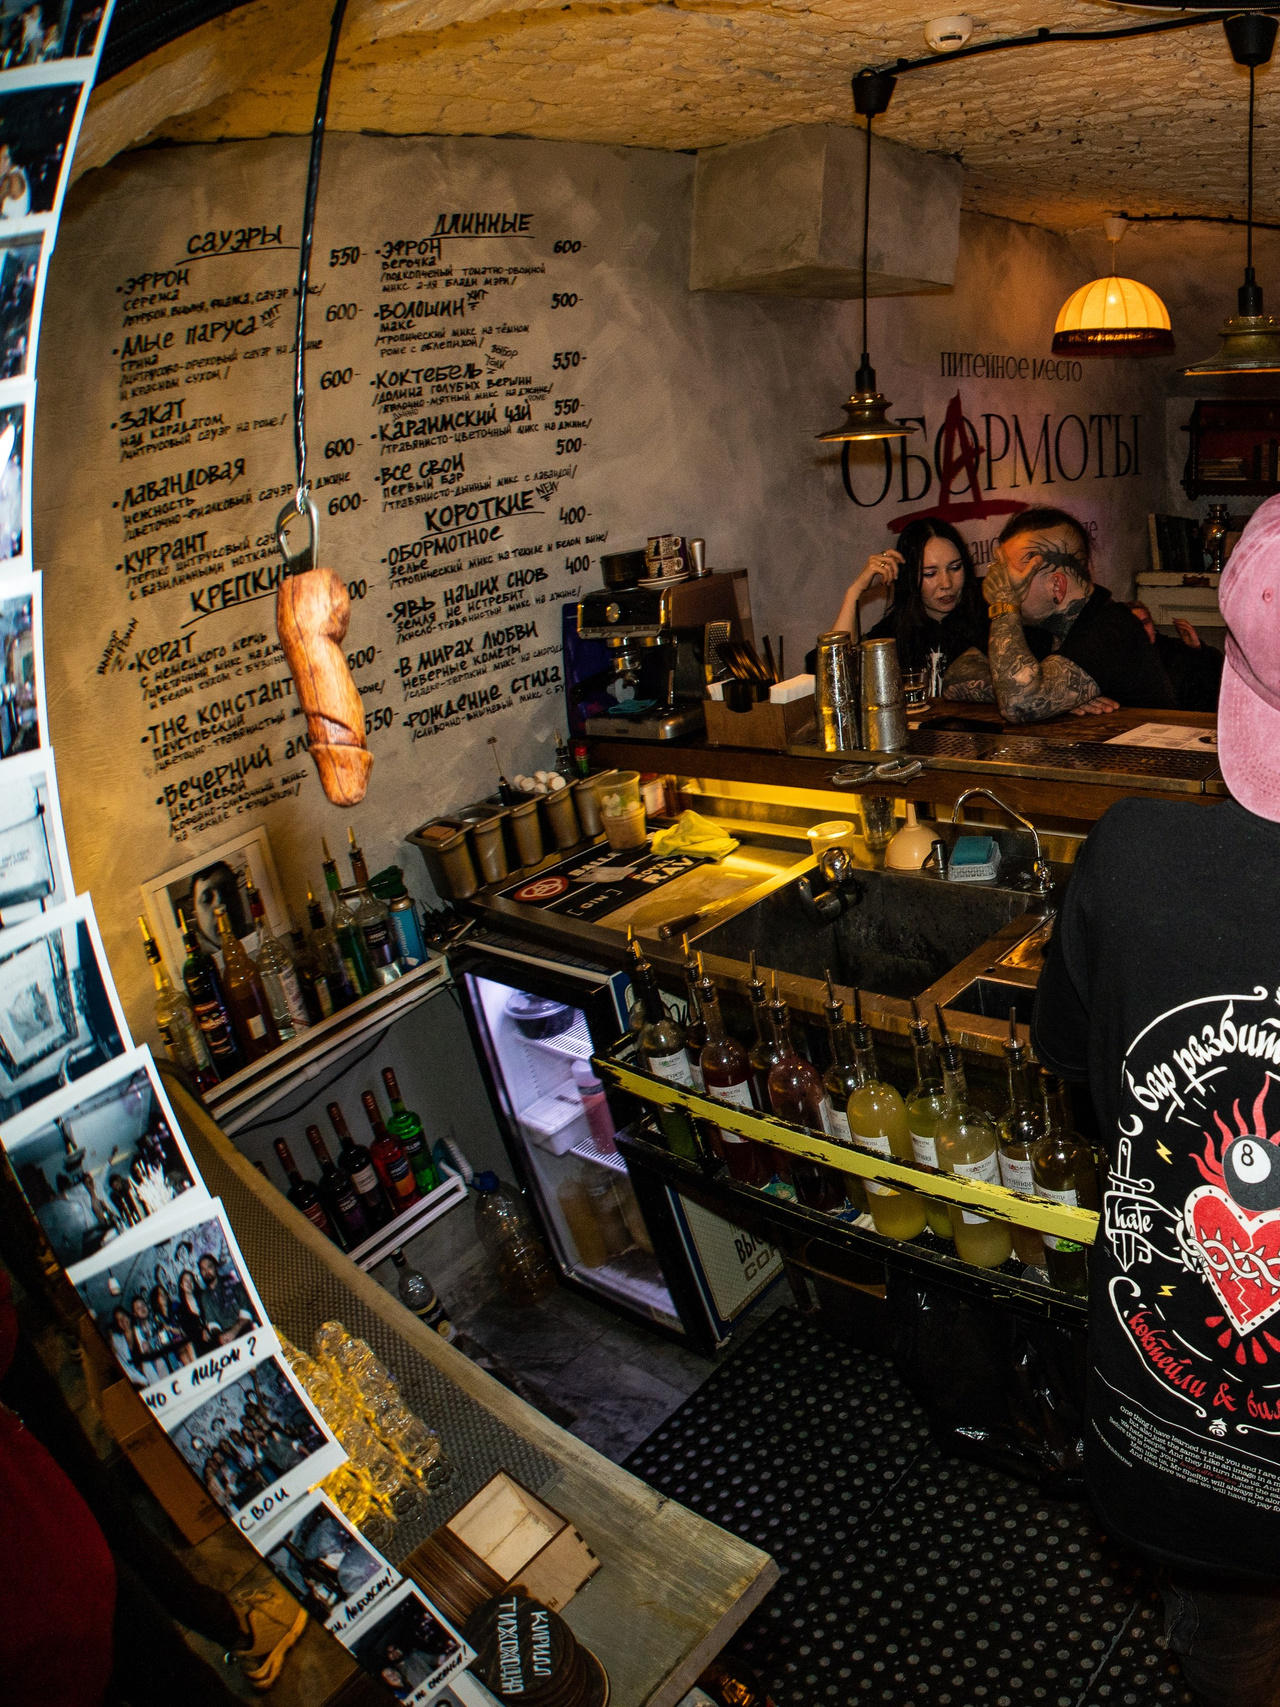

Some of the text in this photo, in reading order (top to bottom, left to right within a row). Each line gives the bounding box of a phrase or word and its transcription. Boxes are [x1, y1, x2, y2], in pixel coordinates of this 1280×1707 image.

[1240, 1143, 1254, 1167] 8
[1115, 1198, 1153, 1233] hate
[1213, 1383, 1238, 1411] &
[1120, 1406, 1133, 1416] One
[1134, 1414, 1149, 1429] thing
[1153, 1427, 1170, 1439] have
[1171, 1435, 1199, 1452] learned
[1209, 1452, 1224, 1461] that
[1226, 1458, 1240, 1468] you
[1241, 1464, 1256, 1473] and
[1129, 1418, 1139, 1428] but
[1140, 1427, 1152, 1437] also
[1151, 1435, 1166, 1444] just
[1167, 1441, 1179, 1450] the
[1203, 1456, 1220, 1466] Like
[1233, 1467, 1256, 1479] image
[1257, 1475, 1265, 1483] in
